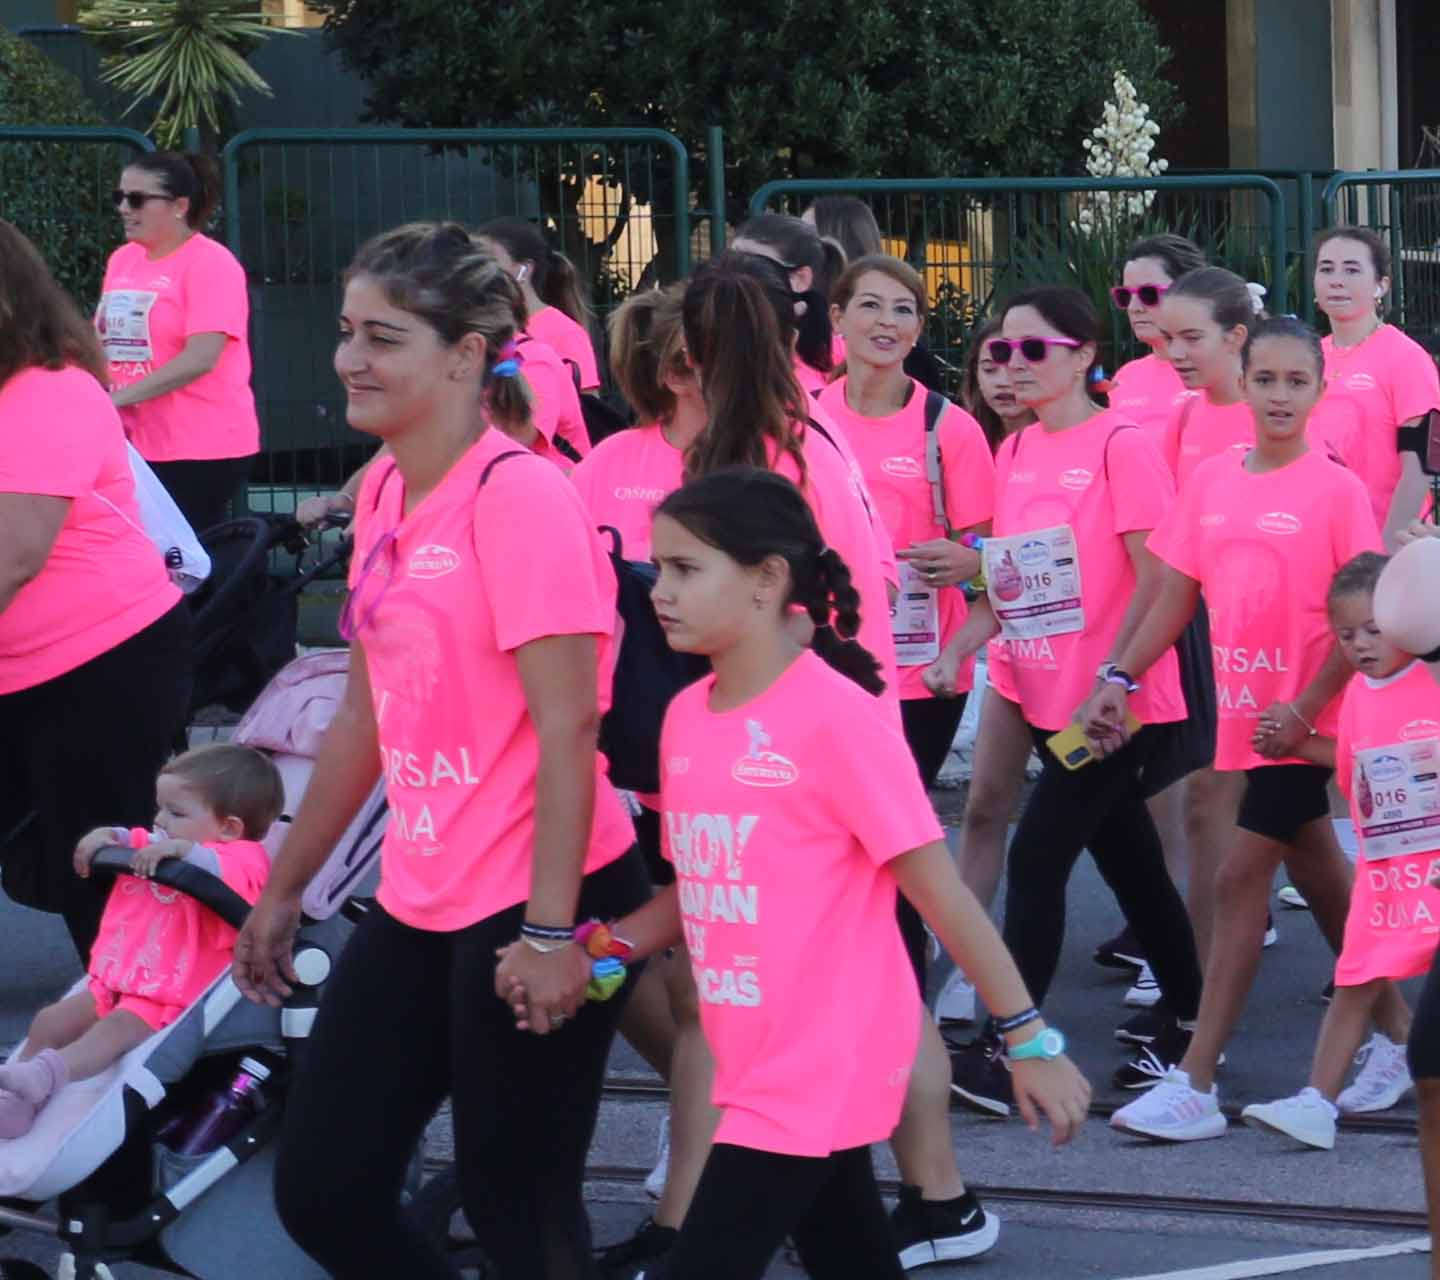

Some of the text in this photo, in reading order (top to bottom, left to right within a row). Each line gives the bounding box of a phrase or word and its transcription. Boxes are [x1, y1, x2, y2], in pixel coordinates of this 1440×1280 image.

[1024, 572, 1052, 590] 016
[1374, 788, 1407, 808] 016
[666, 810, 760, 881] HOY
